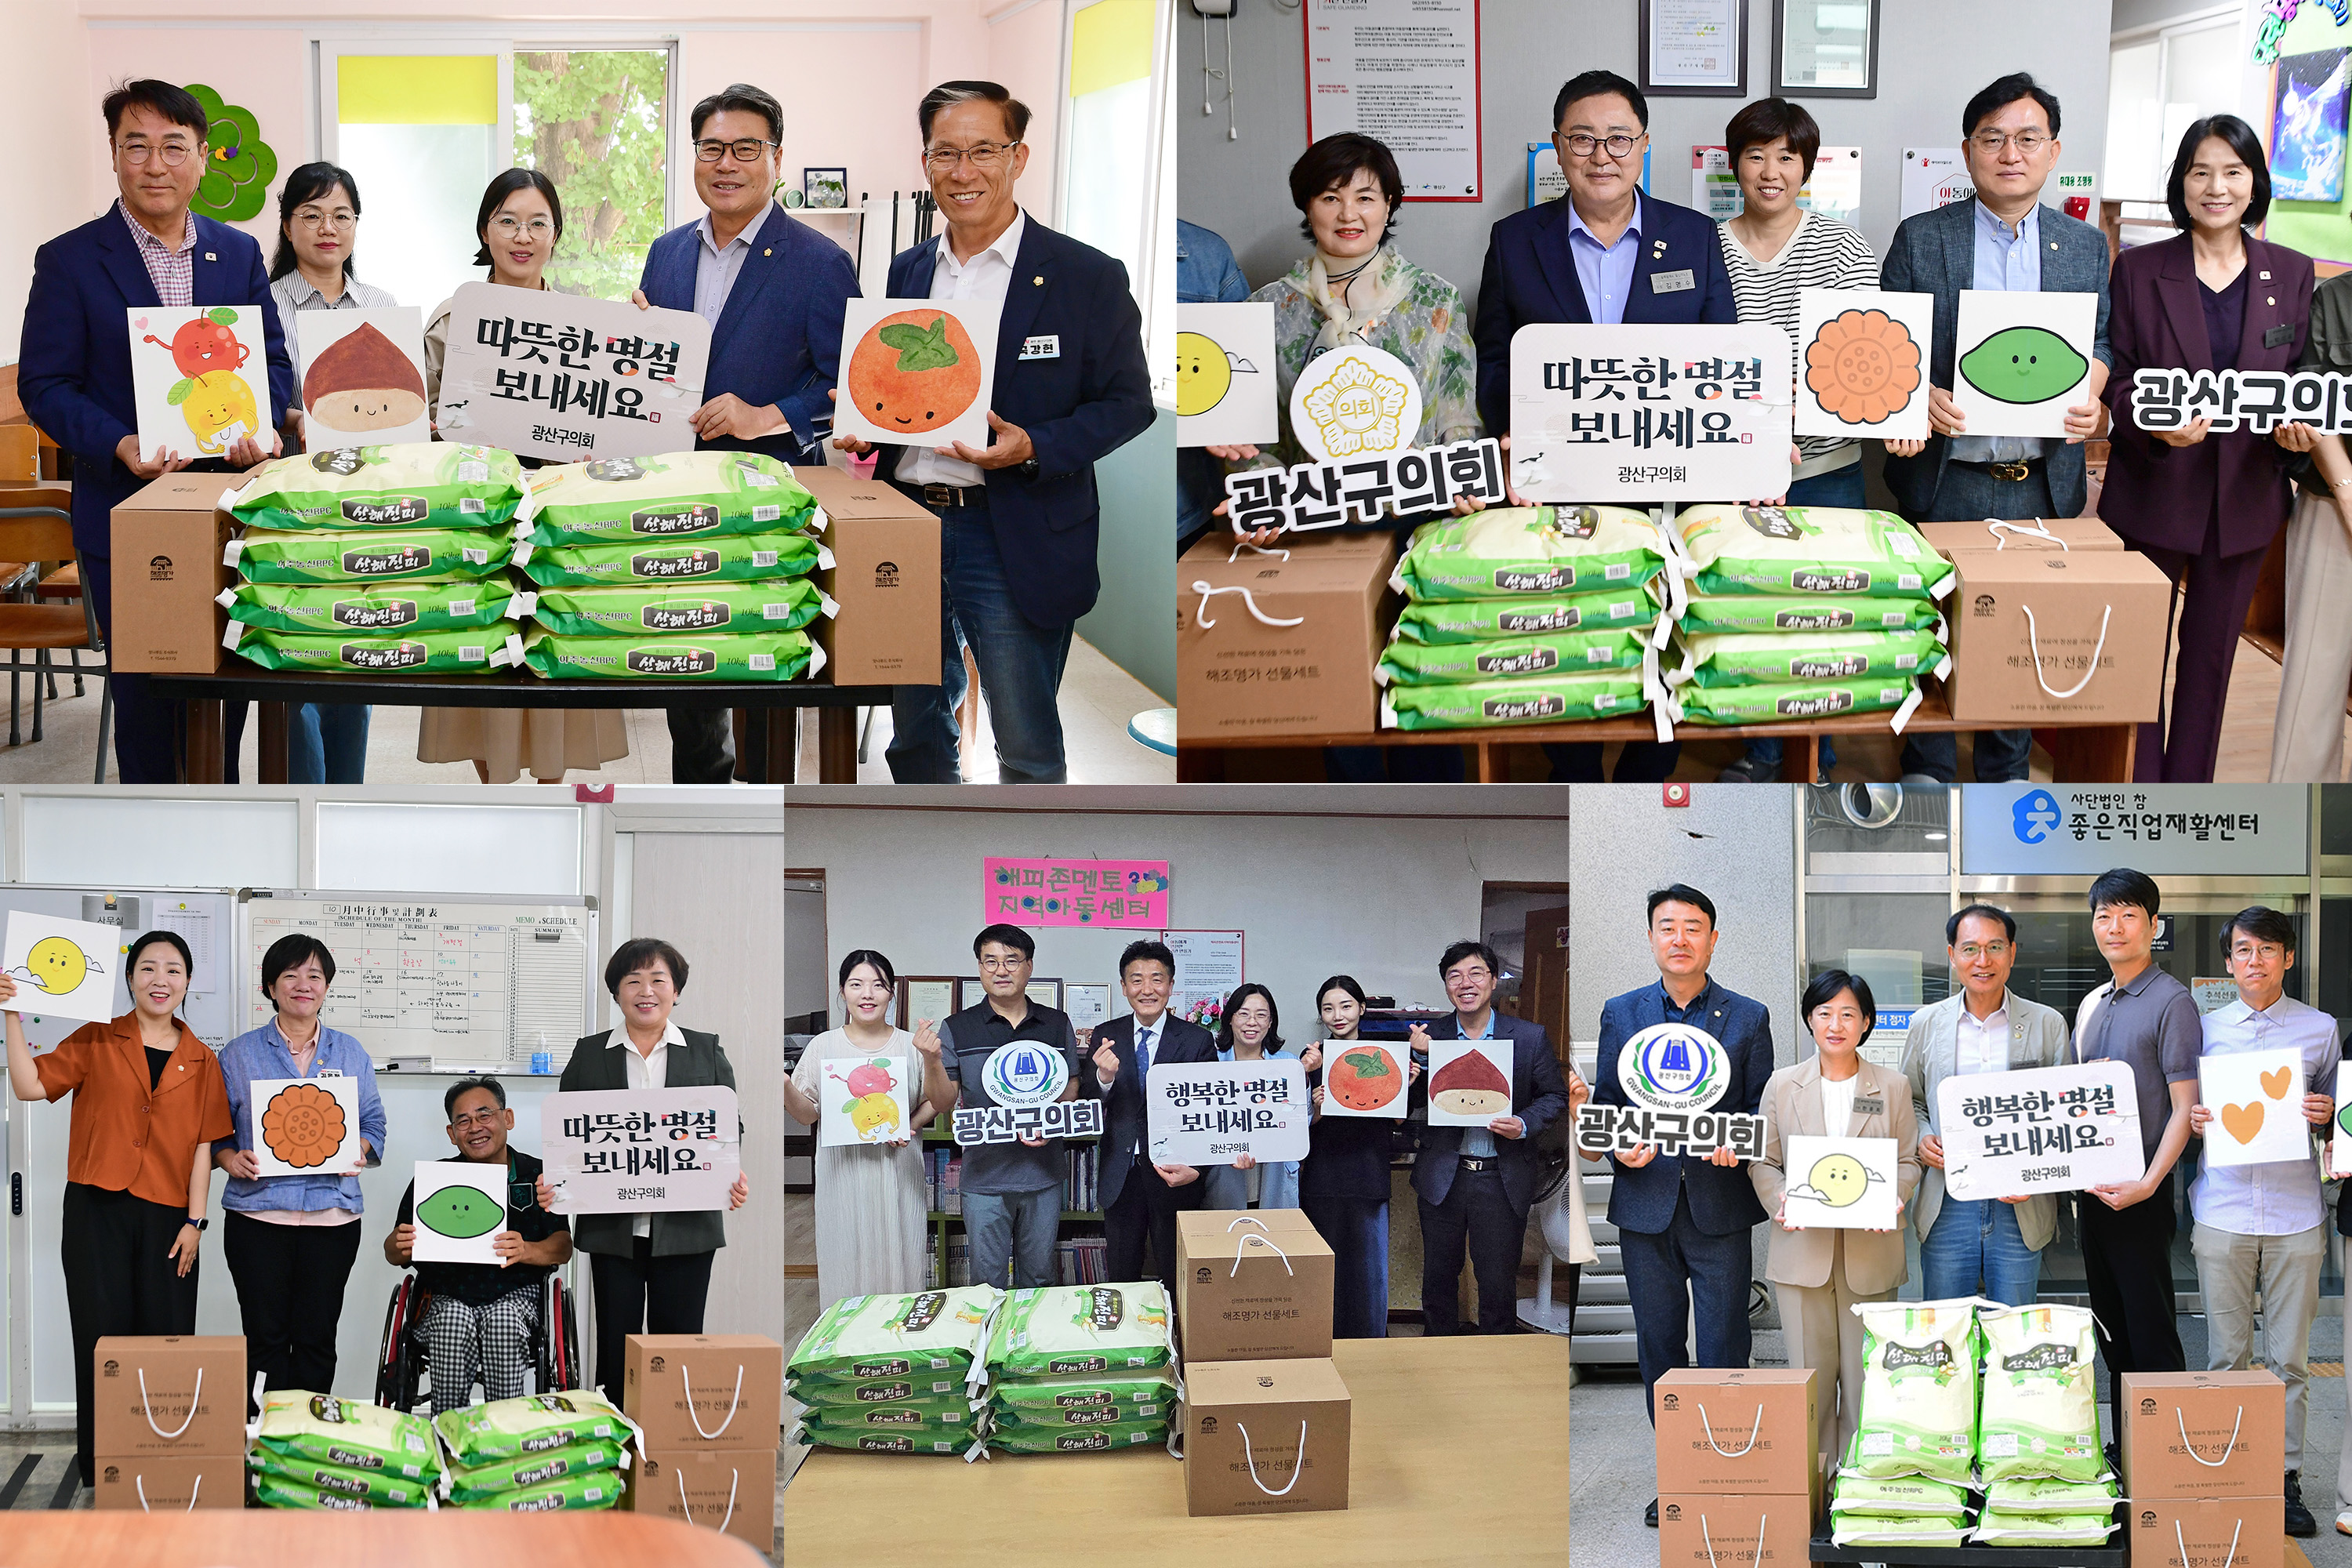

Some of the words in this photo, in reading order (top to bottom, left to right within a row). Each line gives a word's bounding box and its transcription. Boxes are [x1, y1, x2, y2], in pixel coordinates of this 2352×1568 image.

[2060, 176, 2075, 187] 휴대용
[2077, 176, 2093, 187] 조명등
[477, 316, 600, 370] 따뜻한
[605, 335, 681, 383] 명절
[1544, 356, 1678, 401] 따뜻한
[1685, 357, 1763, 401] 명절
[490, 368, 648, 421] 보내세요
[1339, 397, 1377, 420] 의회
[532, 424, 595, 449] 광산구의회
[1566, 406, 1740, 450] 보내세요
[1617, 466, 1686, 483] 광산구의회
[1232, 443, 1501, 534] 광산구의회
[353, 504, 416, 522] 산해진미
[438, 503, 457, 511] 10kg
[731, 510, 750, 520] 10kg
[643, 514, 708, 532] 산해진미
[355, 556, 418, 573] 산해진미
[441, 552, 460, 561] 10kg
[731, 555, 750, 564] 10kg
[643, 558, 708, 576] 산해진미
[1504, 574, 1563, 589] 산해진미
[1802, 575, 1859, 590] 산해진미
[344, 608, 405, 624] 산해진미
[653, 608, 718, 627] 산해진미
[741, 608, 760, 617] 10kg
[1509, 615, 1569, 630] 산해진미
[1786, 616, 1843, 629] 산해진미
[353, 649, 415, 666] 산해진미
[437, 650, 456, 659] 10kg
[727, 658, 746, 667] 10kg
[638, 655, 704, 673] 산해진미
[1487, 656, 1546, 672] 산해진미
[1801, 662, 1857, 677] 산해진미
[1206, 666, 1261, 683] 해조명가
[1266, 665, 1321, 681] 선물세트
[1494, 703, 1553, 718] 산해진미
[1786, 699, 1842, 714] 산해진미
[2071, 793, 2125, 810] 사단법인
[2133, 793, 2147, 809] 참
[2067, 812, 2259, 842] 좋은직업재활센터
[993, 866, 1123, 895] 해피존멘토
[999, 895, 1150, 924] 지역아동센터
[97, 916, 124, 925] 사무실
[403, 958, 423, 967] 한글날
[1889, 1014, 1906, 1025] 점자
[1658, 1072, 1692, 1081] 광산구의회
[989, 1084, 1039, 1105] GWANGSAN-GU
[1040, 1080, 1064, 1101] COUNCIL
[1166, 1080, 1240, 1107] 행복한
[1244, 1078, 1290, 1104] 명절
[1626, 1077, 1688, 1109] GWANGSAN-GU
[1688, 1082, 1723, 1108] COUNCIL
[1962, 1089, 2056, 1127] 행복한
[2059, 1083, 2117, 1118] 명절
[564, 1111, 657, 1144] 따뜻한
[662, 1109, 718, 1141] 명절
[956, 1102, 1101, 1143] 광산구의회
[1180, 1108, 1279, 1134] 보내세요
[1579, 1108, 1765, 1158] 광산구의회
[1983, 1123, 2105, 1157] 보내세요
[1210, 1142, 1250, 1154] 광산구의회
[581, 1145, 702, 1176] 보내세요
[2021, 1165, 2071, 1182] 광산구의회
[617, 1186, 666, 1200] 광산구의회
[906, 1294, 937, 1329] 산해진미
[1095, 1290, 1112, 1326] 산해진미
[1223, 1310, 1260, 1321] 해조명가
[1262, 1309, 1300, 1320] 선물세트
[1887, 1348, 1948, 1367] 산해진미
[2008, 1352, 2072, 1369] 산해진미
[860, 1366, 902, 1377] 산해진미
[1056, 1362, 1099, 1373] 산해진미
[864, 1389, 905, 1401] 산해진미
[1062, 1397, 1105, 1406] 산해진미
[1071, 1412, 1112, 1423] 산해진미
[866, 1441, 906, 1450] 산해진미
[1062, 1439, 1103, 1450] 산해진미
[1229, 1460, 1270, 1473] 해조명가
